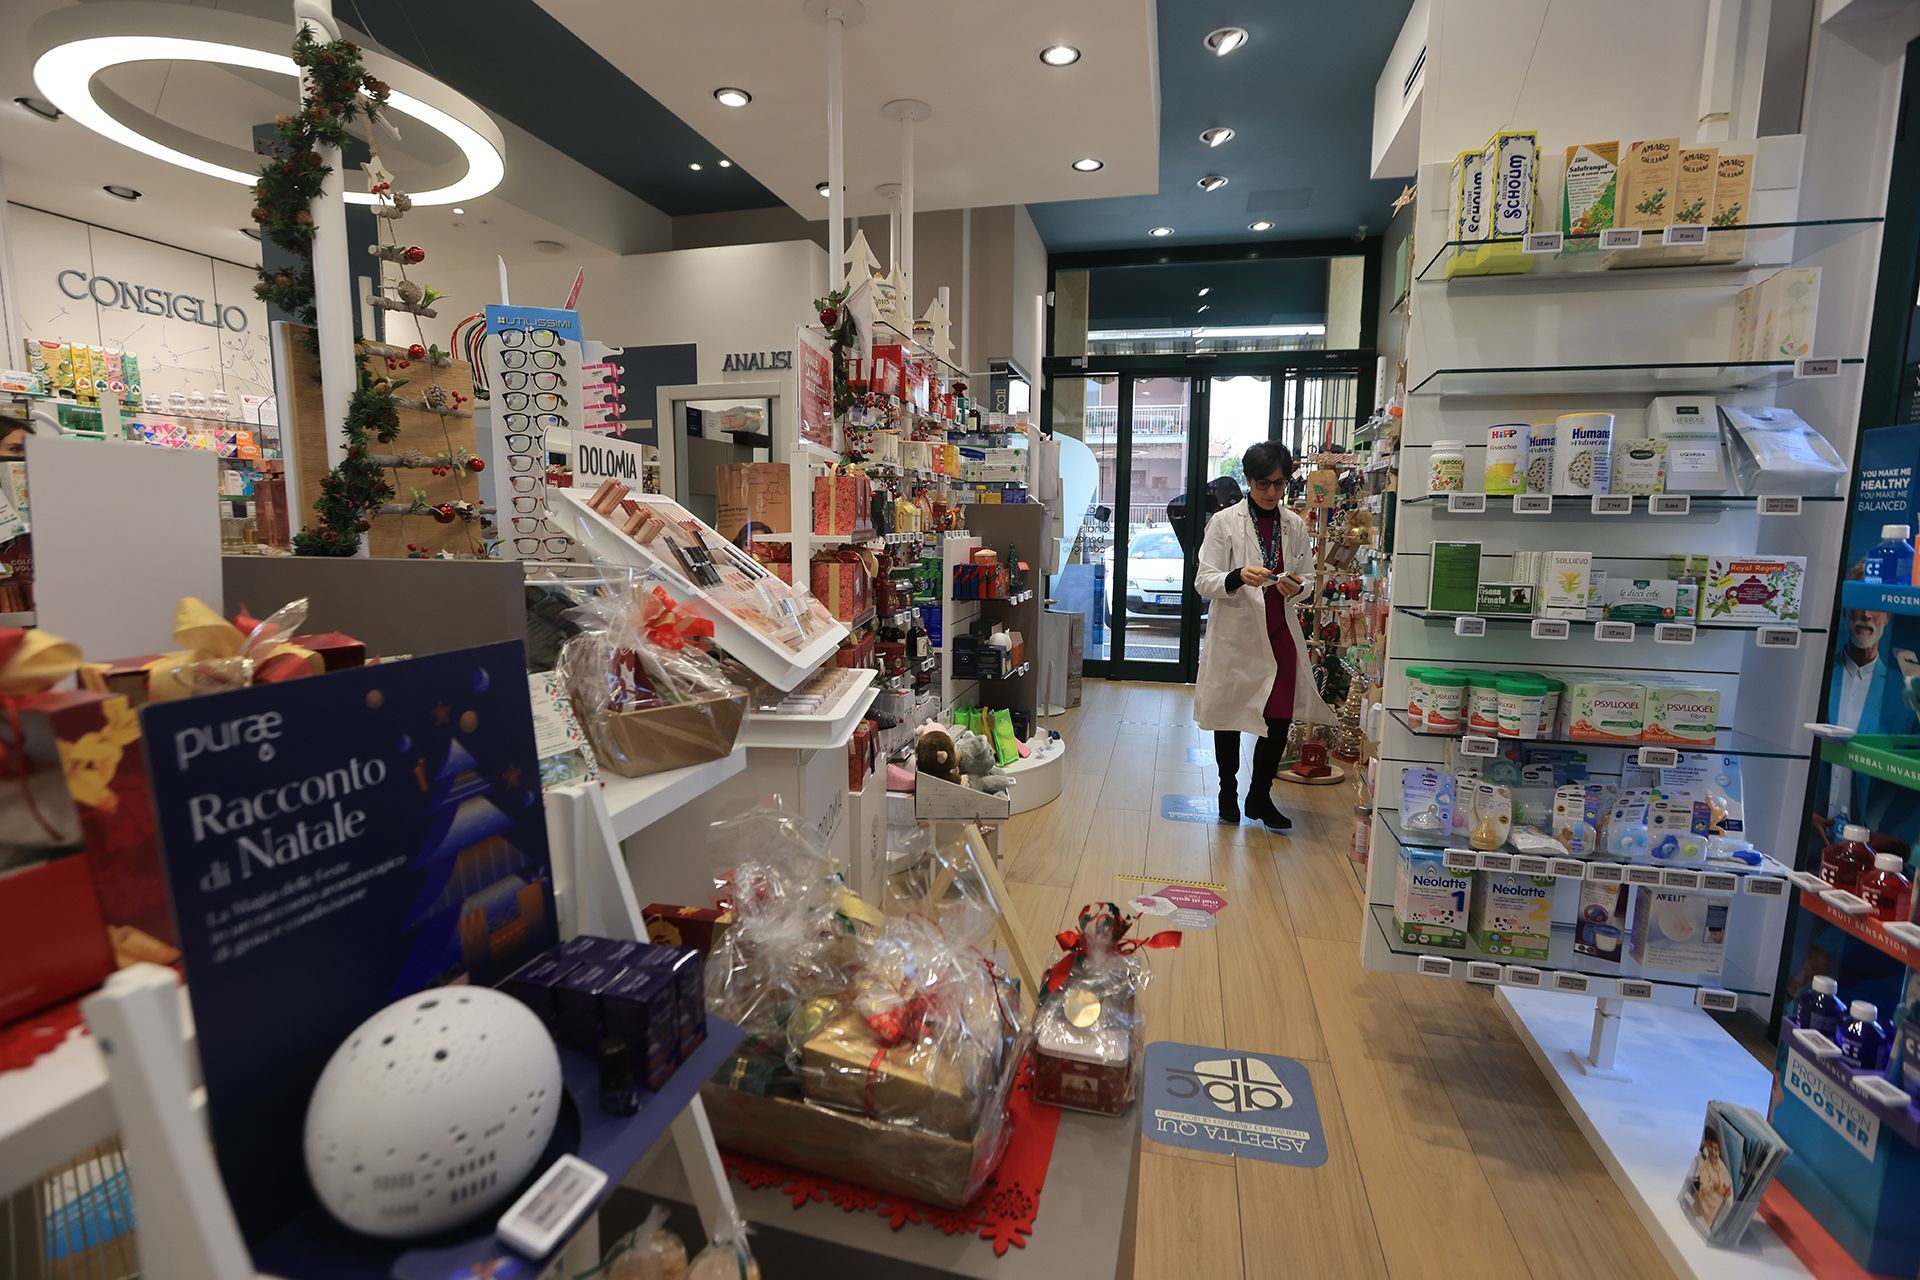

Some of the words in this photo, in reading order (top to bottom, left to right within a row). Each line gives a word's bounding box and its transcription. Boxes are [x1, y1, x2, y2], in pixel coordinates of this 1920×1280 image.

[1641, 143, 1670, 155] AMARO
[1640, 153, 1669, 164] GIULIANI
[1682, 153, 1710, 163] AMARO
[1717, 158, 1745, 169] AMARO
[1569, 163, 1608, 173] Salufrangol
[1682, 163, 1709, 173] GIULIANI
[1717, 169, 1745, 178] GIULIANI
[1503, 154, 1527, 219] SCHOUM
[57, 268, 250, 333] CONSIGLIO
[505, 316, 572, 329] UTILISSIMI
[721, 350, 793, 373] ANALISI
[1491, 429, 1518, 439] HiPP
[1529, 437, 1556, 447] Huma
[578, 444, 638, 480] DOLOMIA
[1862, 470, 1877, 478] YOU
[1877, 468, 1899, 477] MAKE
[1900, 467, 1912, 476] ME
[1860, 478, 1911, 490] HEALTHY
[1859, 491, 1875, 499] YOU
[1876, 490, 1896, 498] MAKE
[1897, 489, 1908, 498] ME
[1858, 500, 1907, 512] BALANCED
[1555, 557, 1589, 565] SOLLIEVO
[1731, 564, 1752, 572] Royal
[1754, 565, 1783, 573] Regime
[1881, 594, 1920, 606] FROZEN
[1594, 699, 1640, 709] PSYLLOGEL
[1667, 703, 1714, 713] PSYLLOGEL
[1690, 712, 1707, 720] Fibra
[1848, 752, 1884, 771] HERBAL
[187, 756, 387, 843] Racconto
[199, 858, 232, 893] di
[235, 800, 367, 880] Natale
[1413, 875, 1467, 889] Neolatte
[1492, 883, 1546, 898] Neolatte
[1827, 905, 1852, 925] FRUIT
[1855, 920, 1908, 956] SENSATION
[1791, 1057, 1873, 1131] PROTECTION
[1790, 1071, 1870, 1150] BOOSTER
[1156, 1117, 1198, 1137] QUI
[1203, 1124, 1307, 1154] ASPETTA
